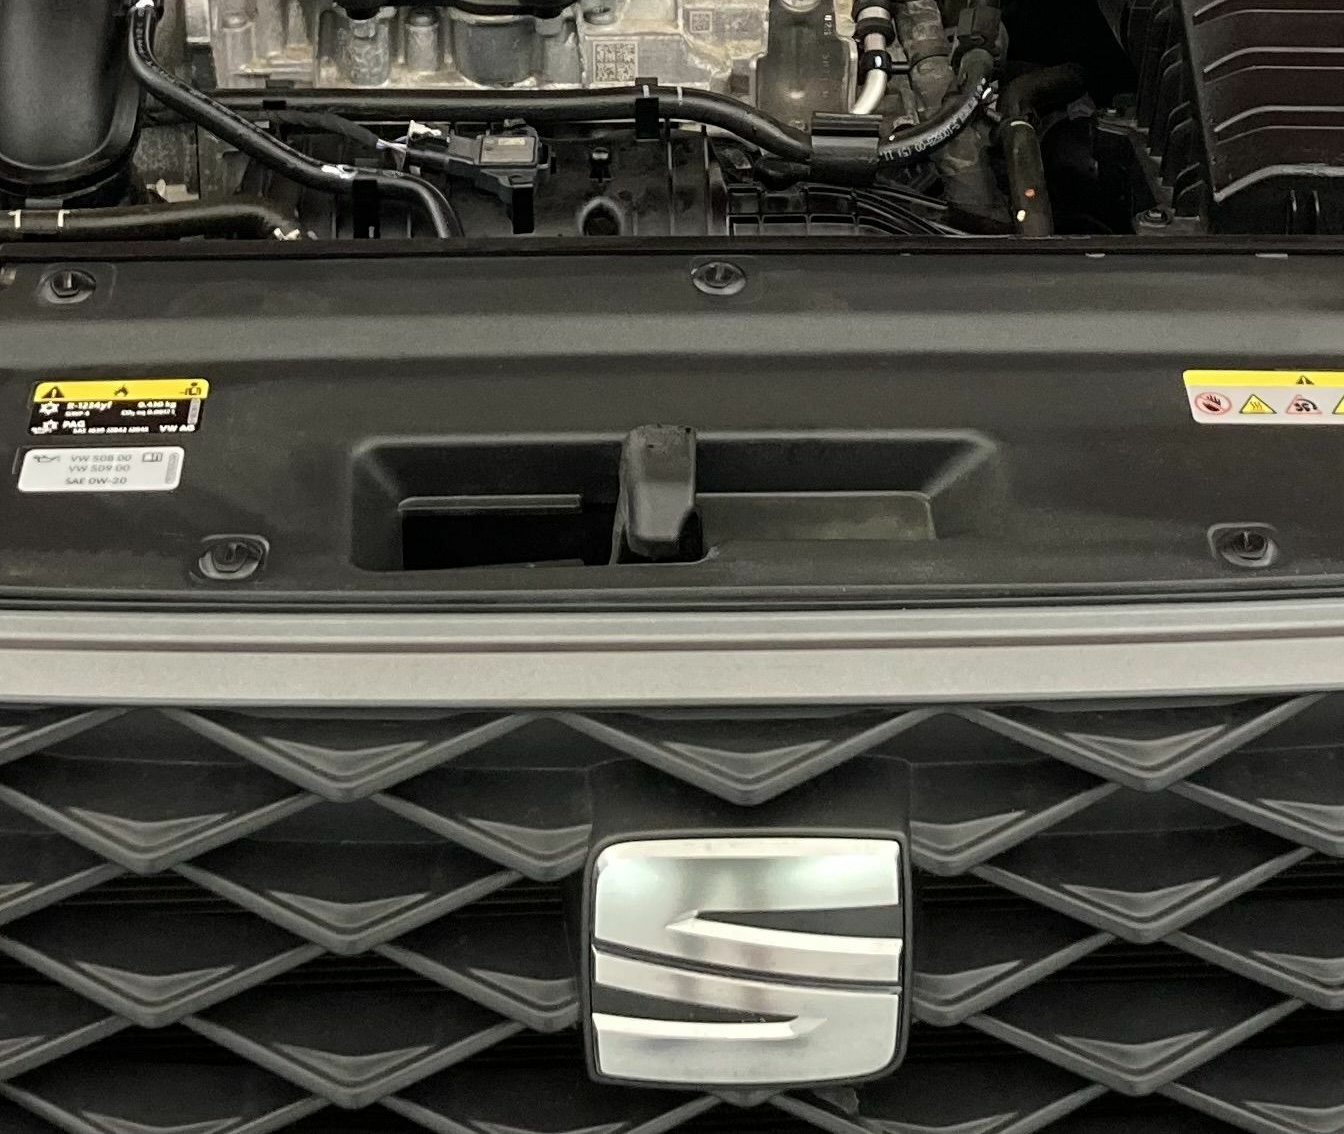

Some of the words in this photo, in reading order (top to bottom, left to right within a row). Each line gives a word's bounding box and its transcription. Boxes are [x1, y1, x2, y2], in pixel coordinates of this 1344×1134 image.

[62, 420, 86, 429] PAG
[159, 425, 177, 433] VW
[117, 454, 132, 462] 00
[90, 464, 112, 472] 509
[115, 464, 131, 472] 00
[66, 477, 85, 485] SAE
[88, 476, 128, 484] 0W-20
